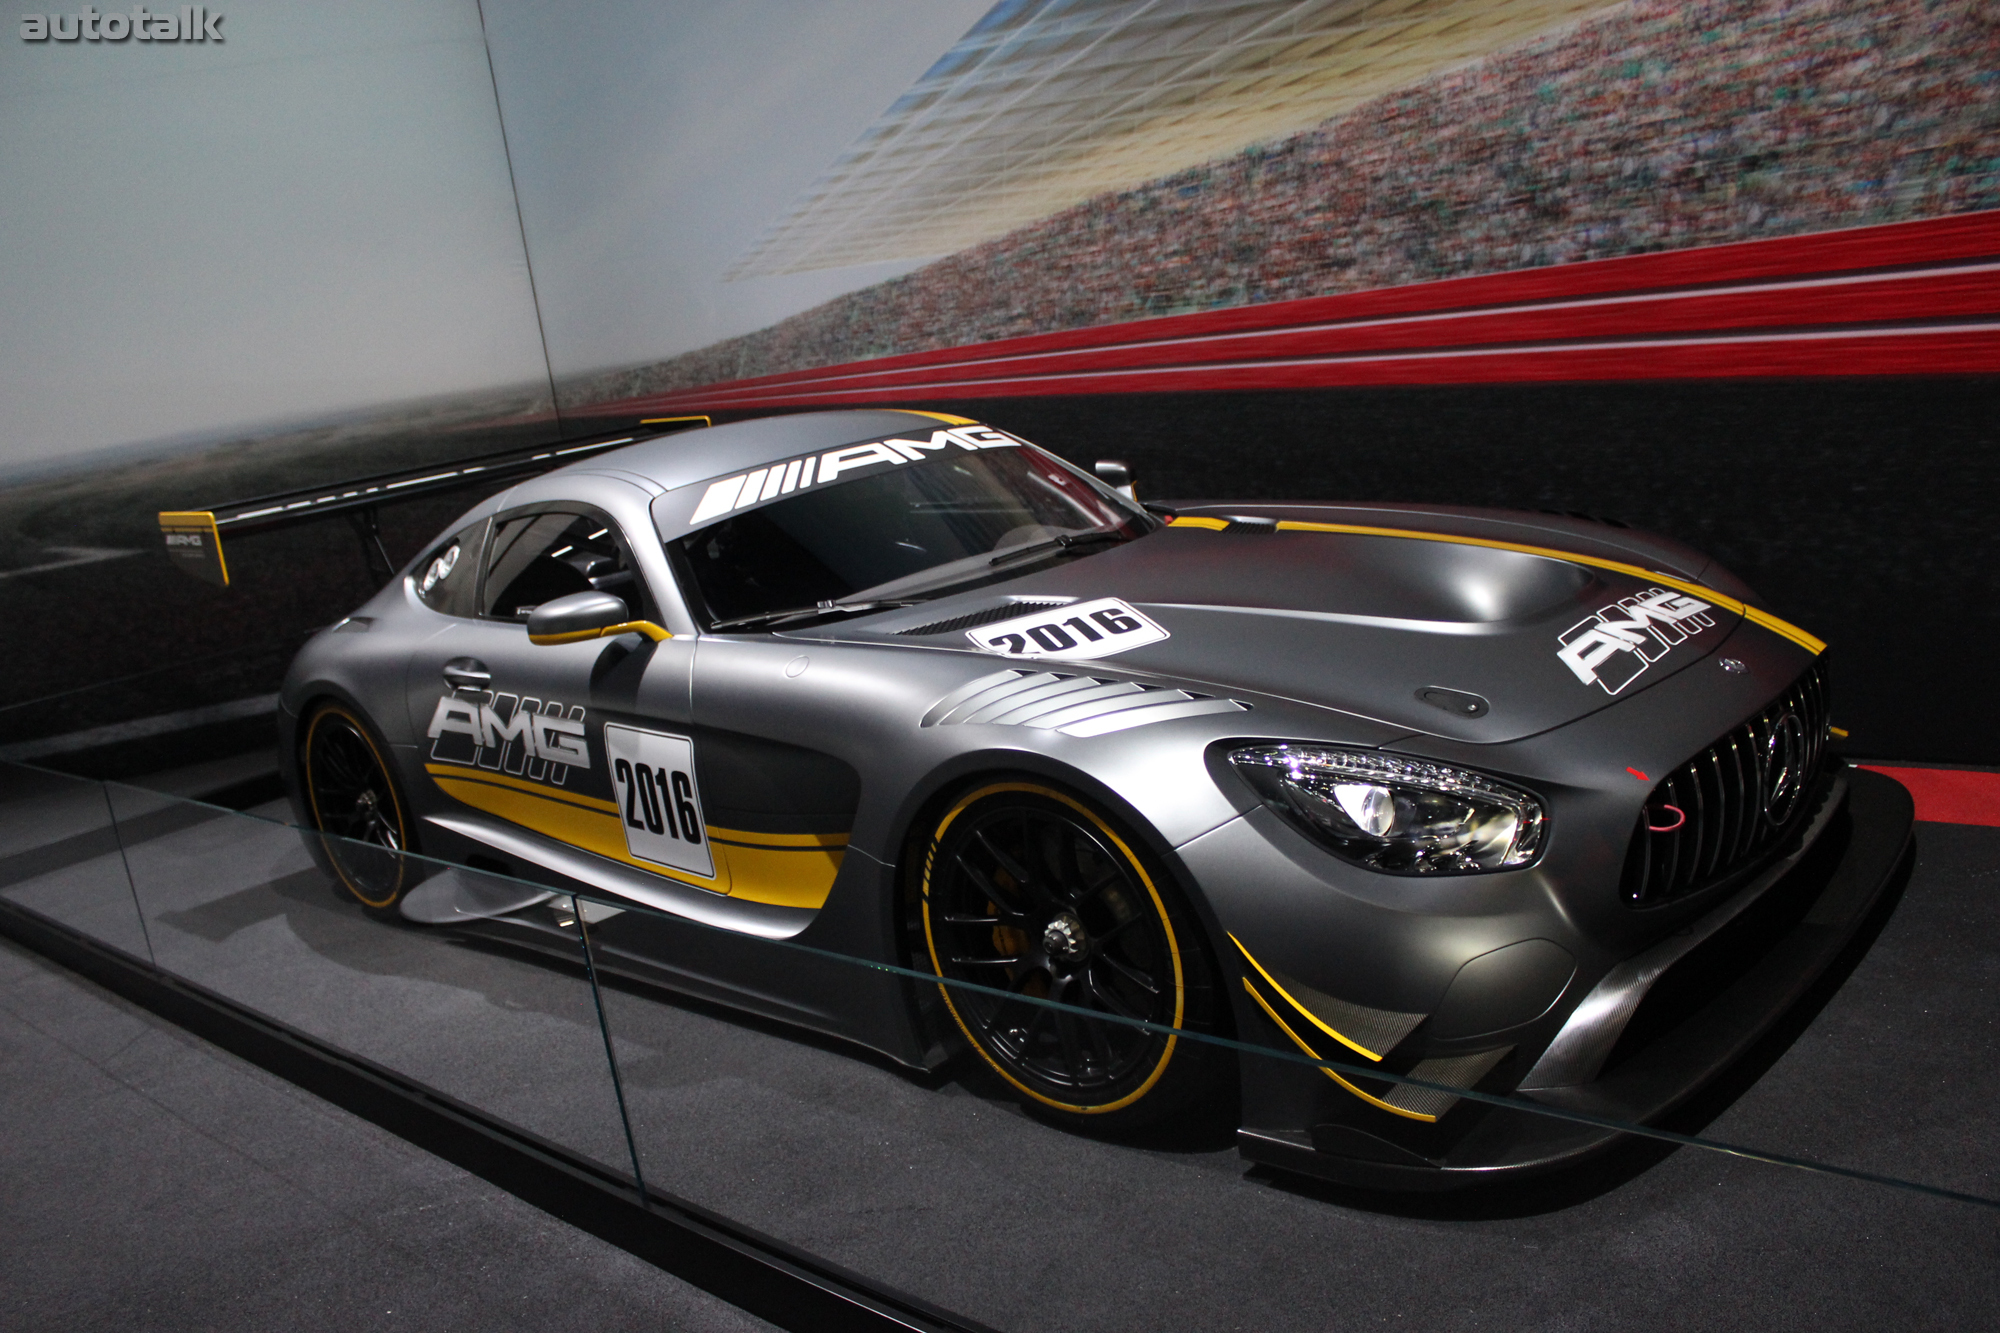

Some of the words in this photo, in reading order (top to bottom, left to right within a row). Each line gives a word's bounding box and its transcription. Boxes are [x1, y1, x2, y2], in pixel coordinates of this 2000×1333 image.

[817, 426, 1022, 483] AMG
[988, 608, 1143, 654] 2016
[1557, 592, 1712, 685] AMG
[427, 697, 590, 769] AMG
[615, 758, 702, 845] 2016
